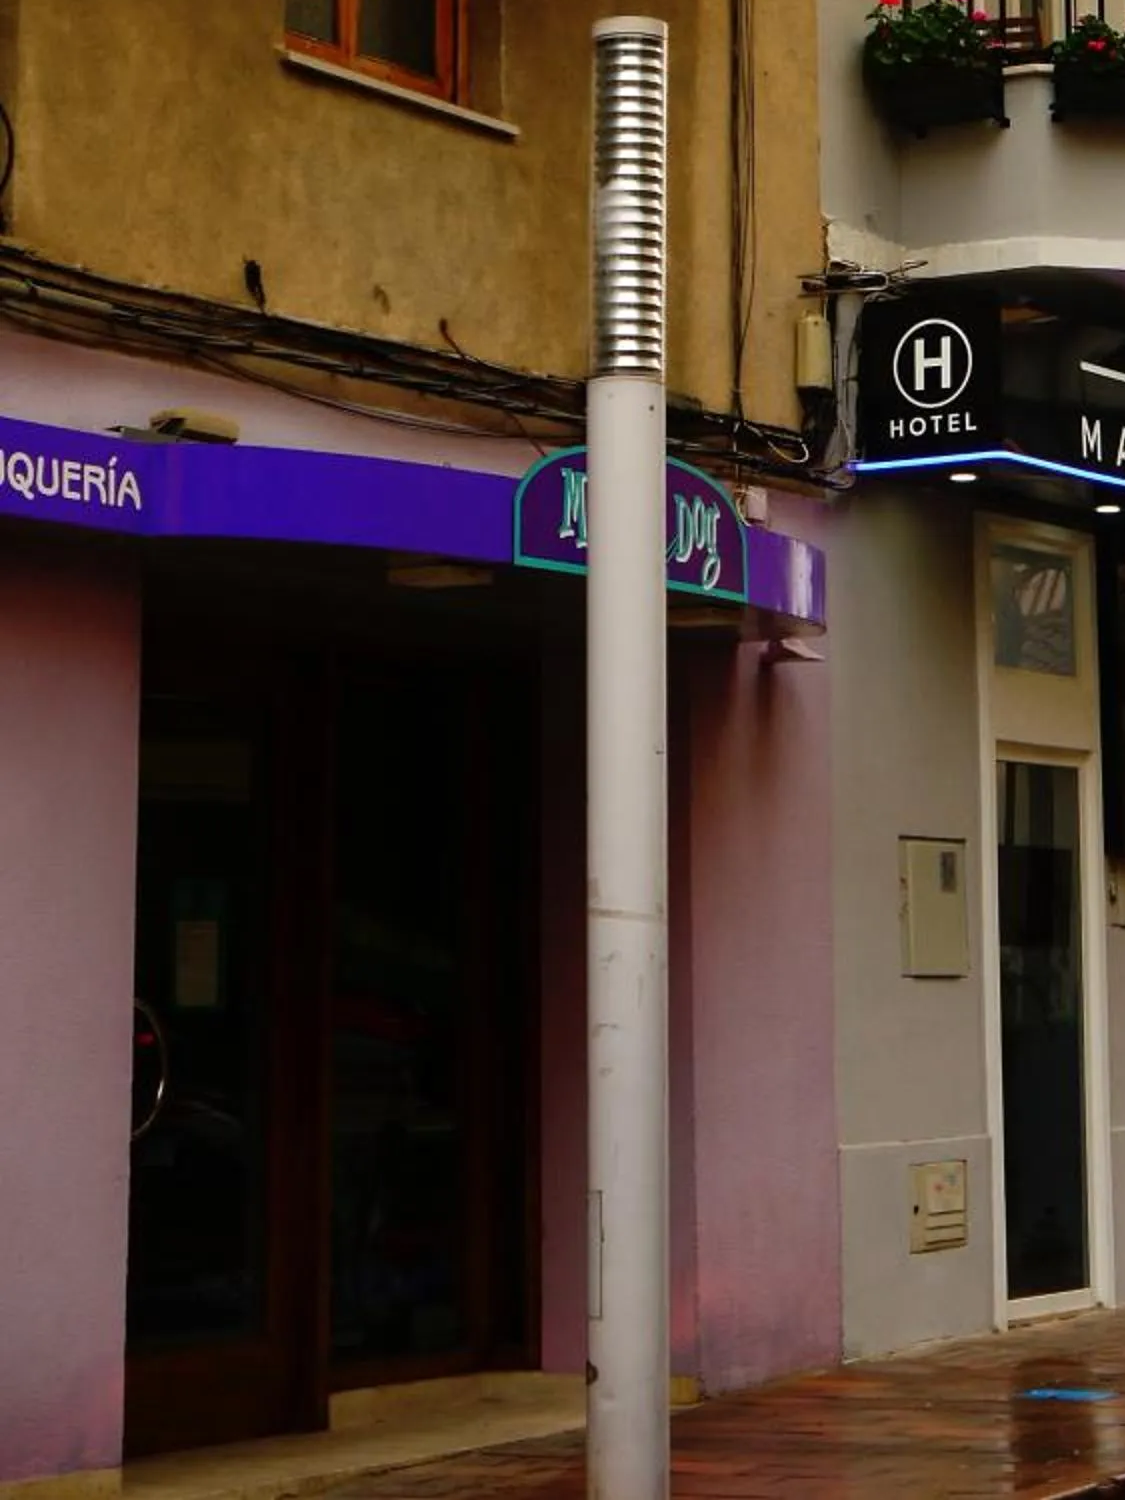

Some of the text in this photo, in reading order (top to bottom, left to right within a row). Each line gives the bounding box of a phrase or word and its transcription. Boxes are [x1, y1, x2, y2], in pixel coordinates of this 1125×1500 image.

[914, 335, 952, 391] H
[889, 411, 978, 439] HOTEL
[0, 449, 141, 510] QUERÍA
